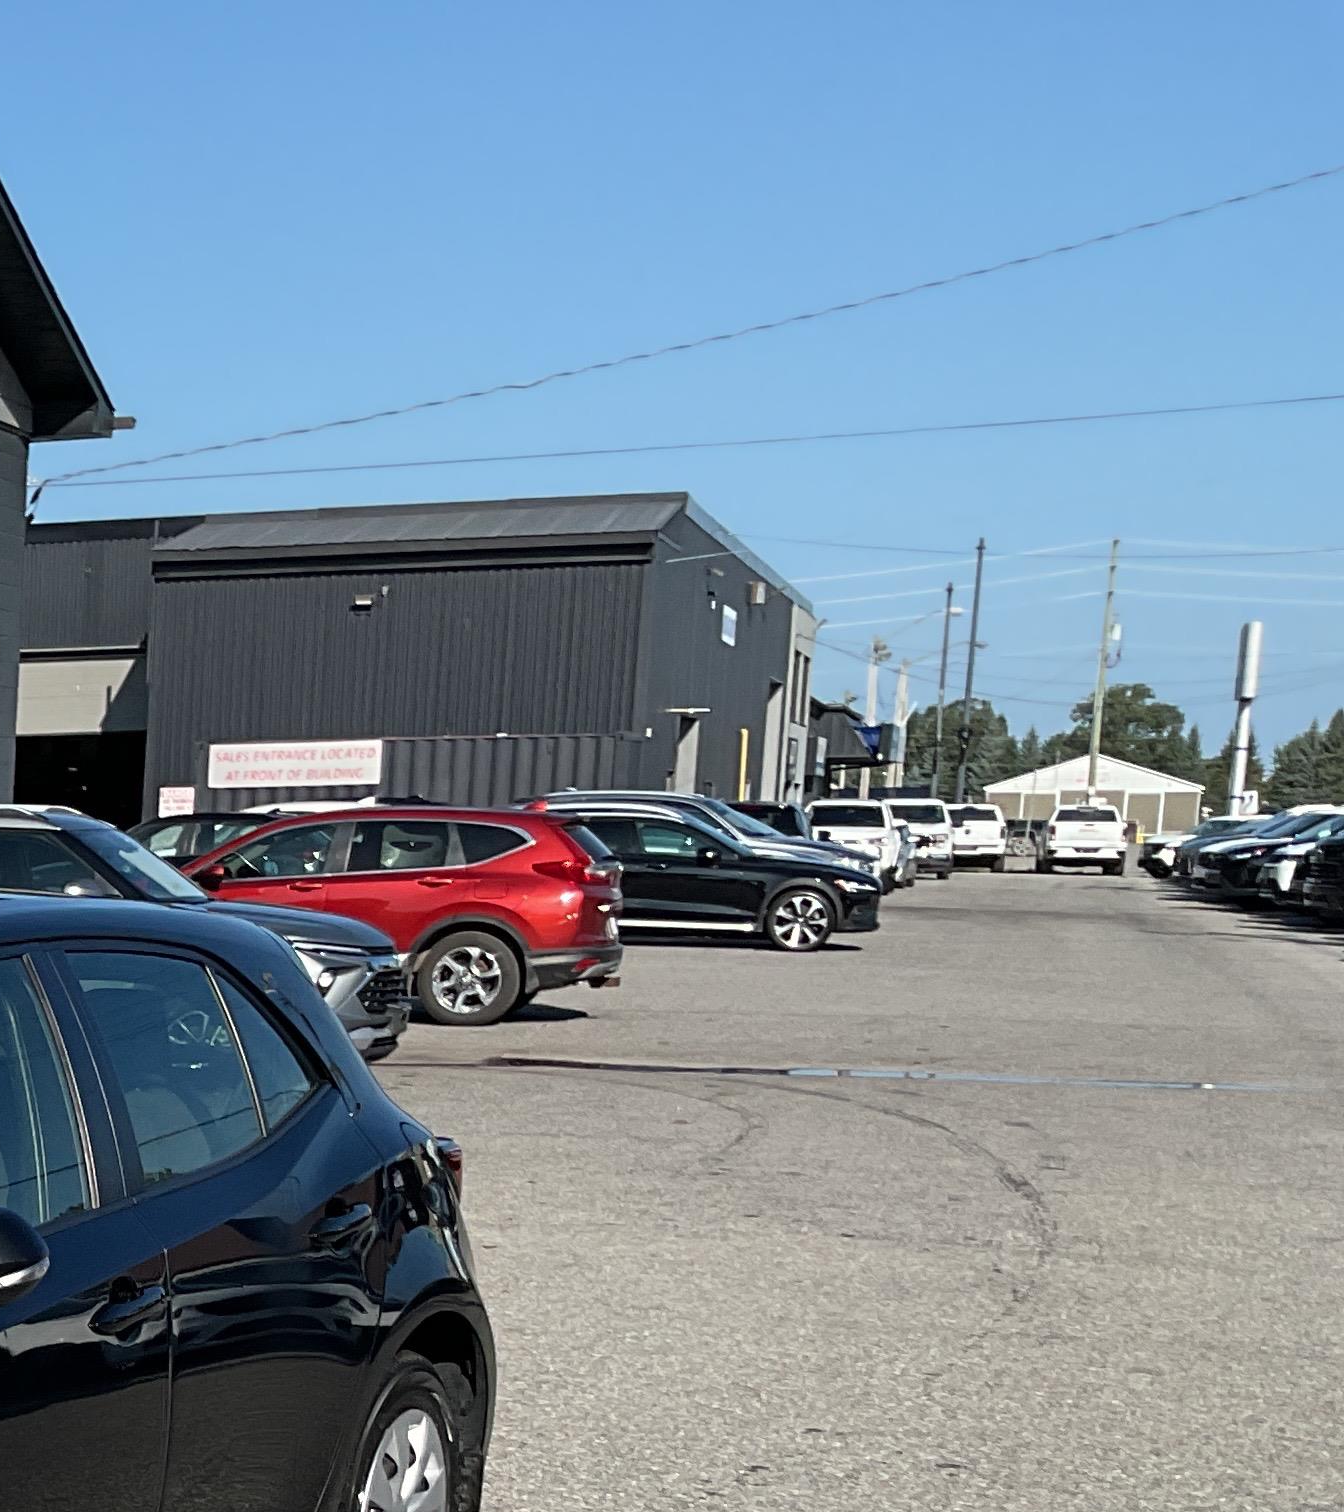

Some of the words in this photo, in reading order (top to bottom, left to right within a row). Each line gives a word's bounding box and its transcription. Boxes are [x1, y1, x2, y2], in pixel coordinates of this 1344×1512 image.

[216, 752, 249, 763] SALES
[253, 749, 316, 762] ENTRANCE
[321, 748, 377, 760] LOCATED
[225, 771, 239, 781] AT
[243, 769, 283, 781] FRONT
[287, 769, 301, 780] OF
[306, 768, 364, 780] BUILDING
